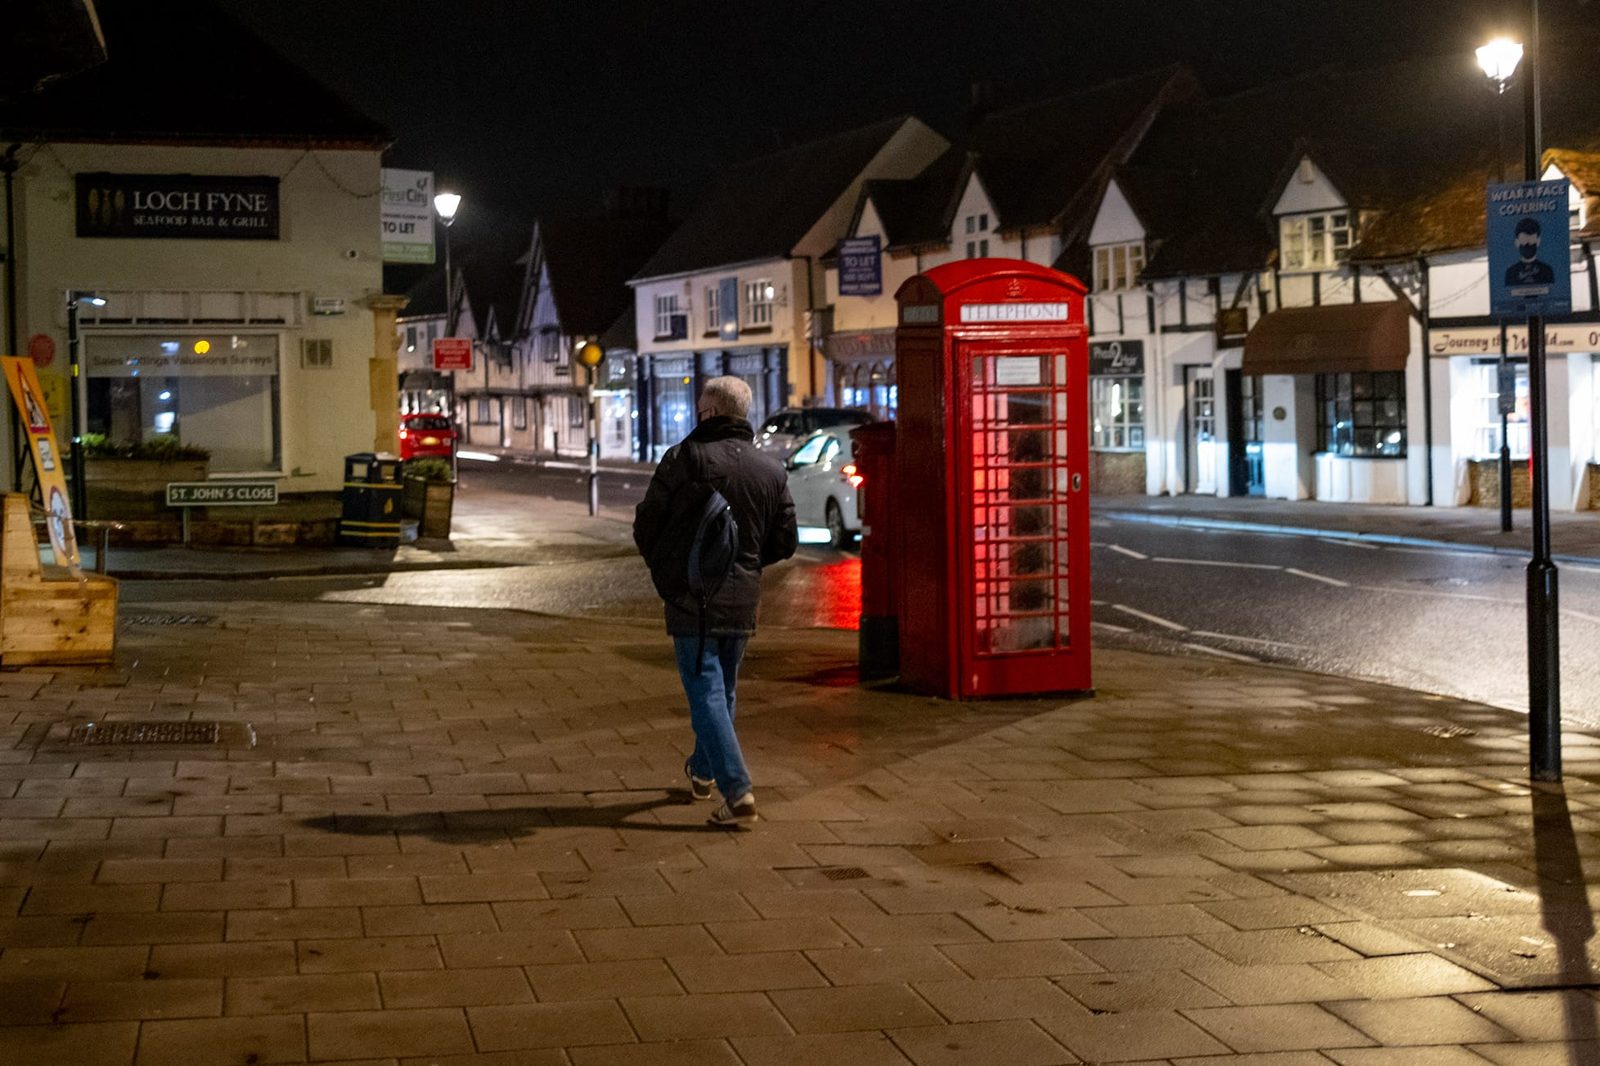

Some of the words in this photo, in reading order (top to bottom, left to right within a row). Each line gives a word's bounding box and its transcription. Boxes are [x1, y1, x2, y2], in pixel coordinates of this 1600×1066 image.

[1491, 189, 1523, 202] WEAR
[1525, 188, 1535, 200] A
[1536, 184, 1566, 198] FACE
[133, 191, 200, 210] LOCH
[207, 192, 268, 212] FYNE
[1499, 201, 1557, 216] COVERING
[133, 215, 187, 226] SEAFOOD
[191, 216, 214, 227] BAR
[218, 216, 228, 227] &
[232, 216, 268, 227] GRILL
[383, 221, 397, 233] TO
[399, 222, 415, 234] LET
[844, 256, 858, 268] TO
[859, 255, 876, 267] LET
[966, 303, 1063, 321] TELEPHONE
[1433, 334, 1489, 351] Journey
[1110, 342, 1123, 367] 2
[236, 487, 274, 499] CLOSE
